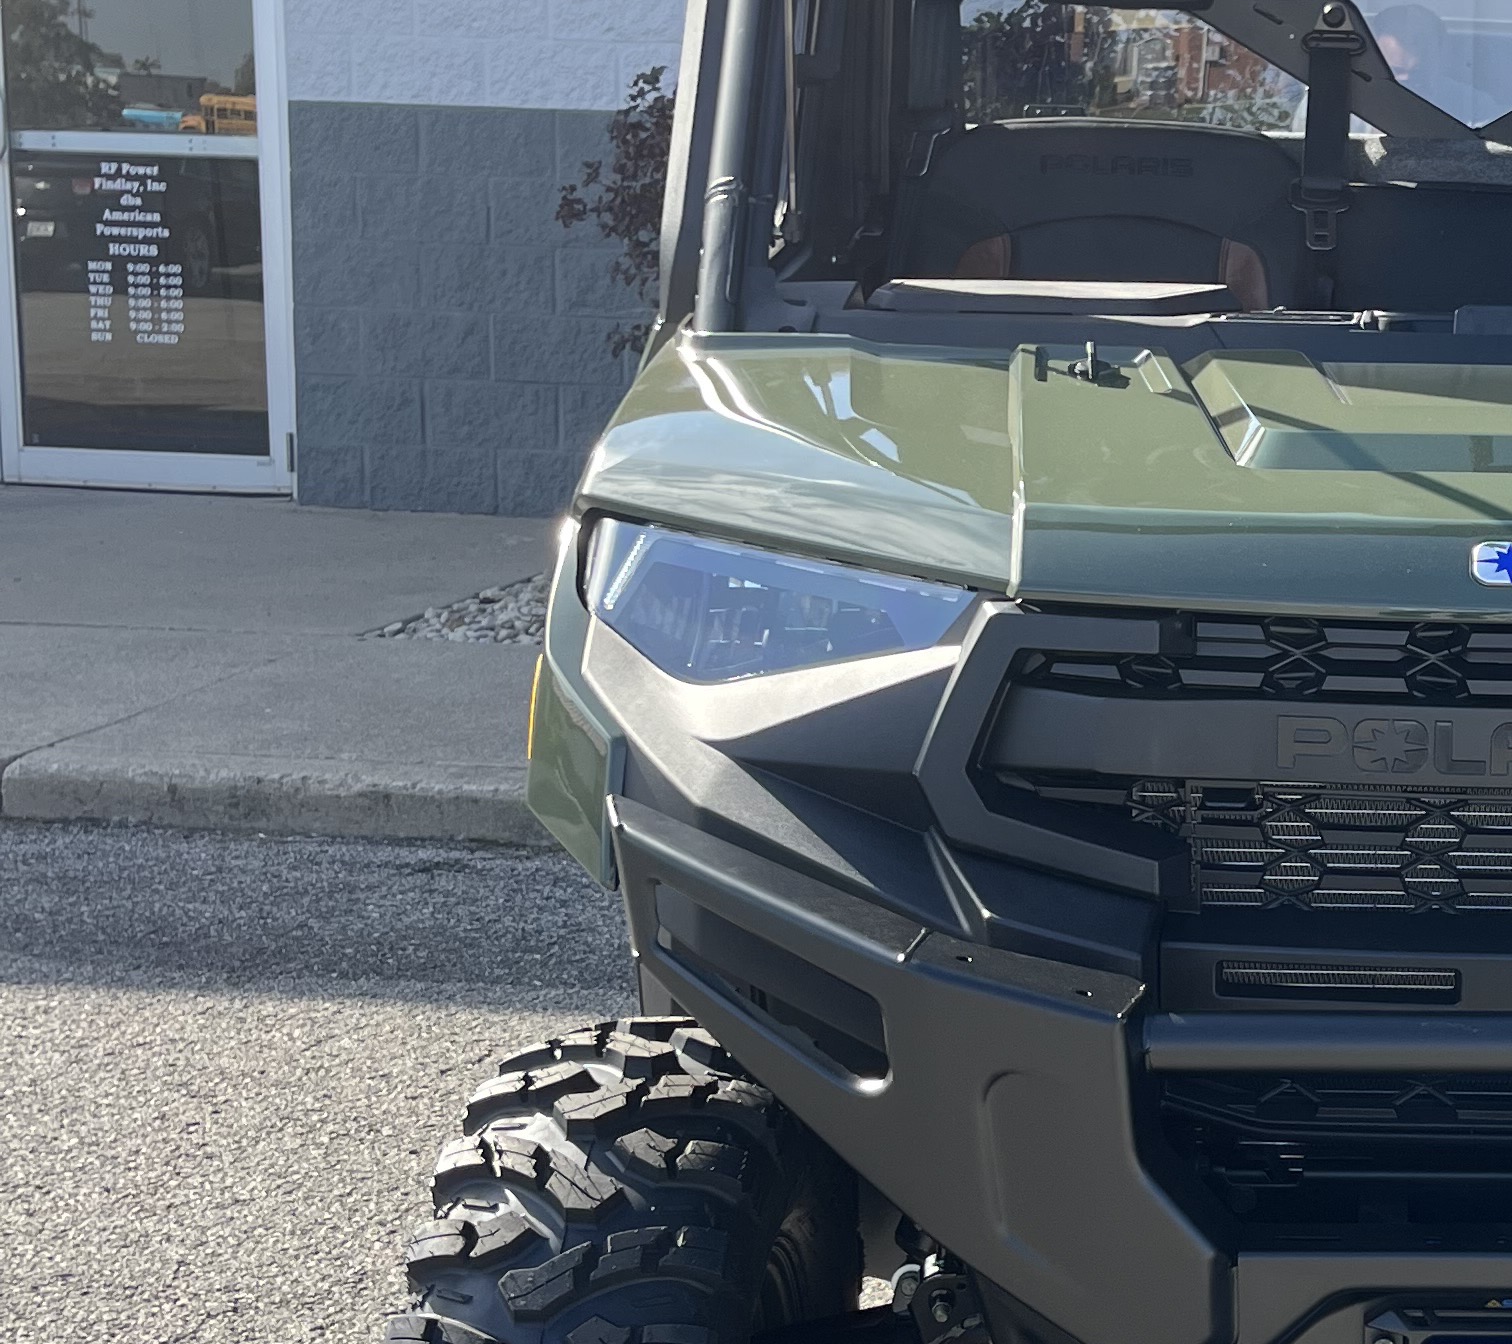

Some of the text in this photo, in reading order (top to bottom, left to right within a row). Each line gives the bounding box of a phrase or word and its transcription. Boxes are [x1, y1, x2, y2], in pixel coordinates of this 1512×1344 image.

[121, 162, 159, 176] Power
[94, 177, 167, 193] Findlay, Inc
[120, 193, 142, 206] dba
[103, 209, 161, 222] American
[96, 223, 170, 239] Powersports
[109, 243, 158, 256] HOURS
[88, 261, 112, 272] MON
[89, 273, 110, 284] TUE
[89, 285, 113, 295] WED
[90, 296, 112, 306] THU
[90, 308, 108, 318] FRI
[91, 320, 110, 330] SAT
[136, 333, 179, 344] CLOSED
